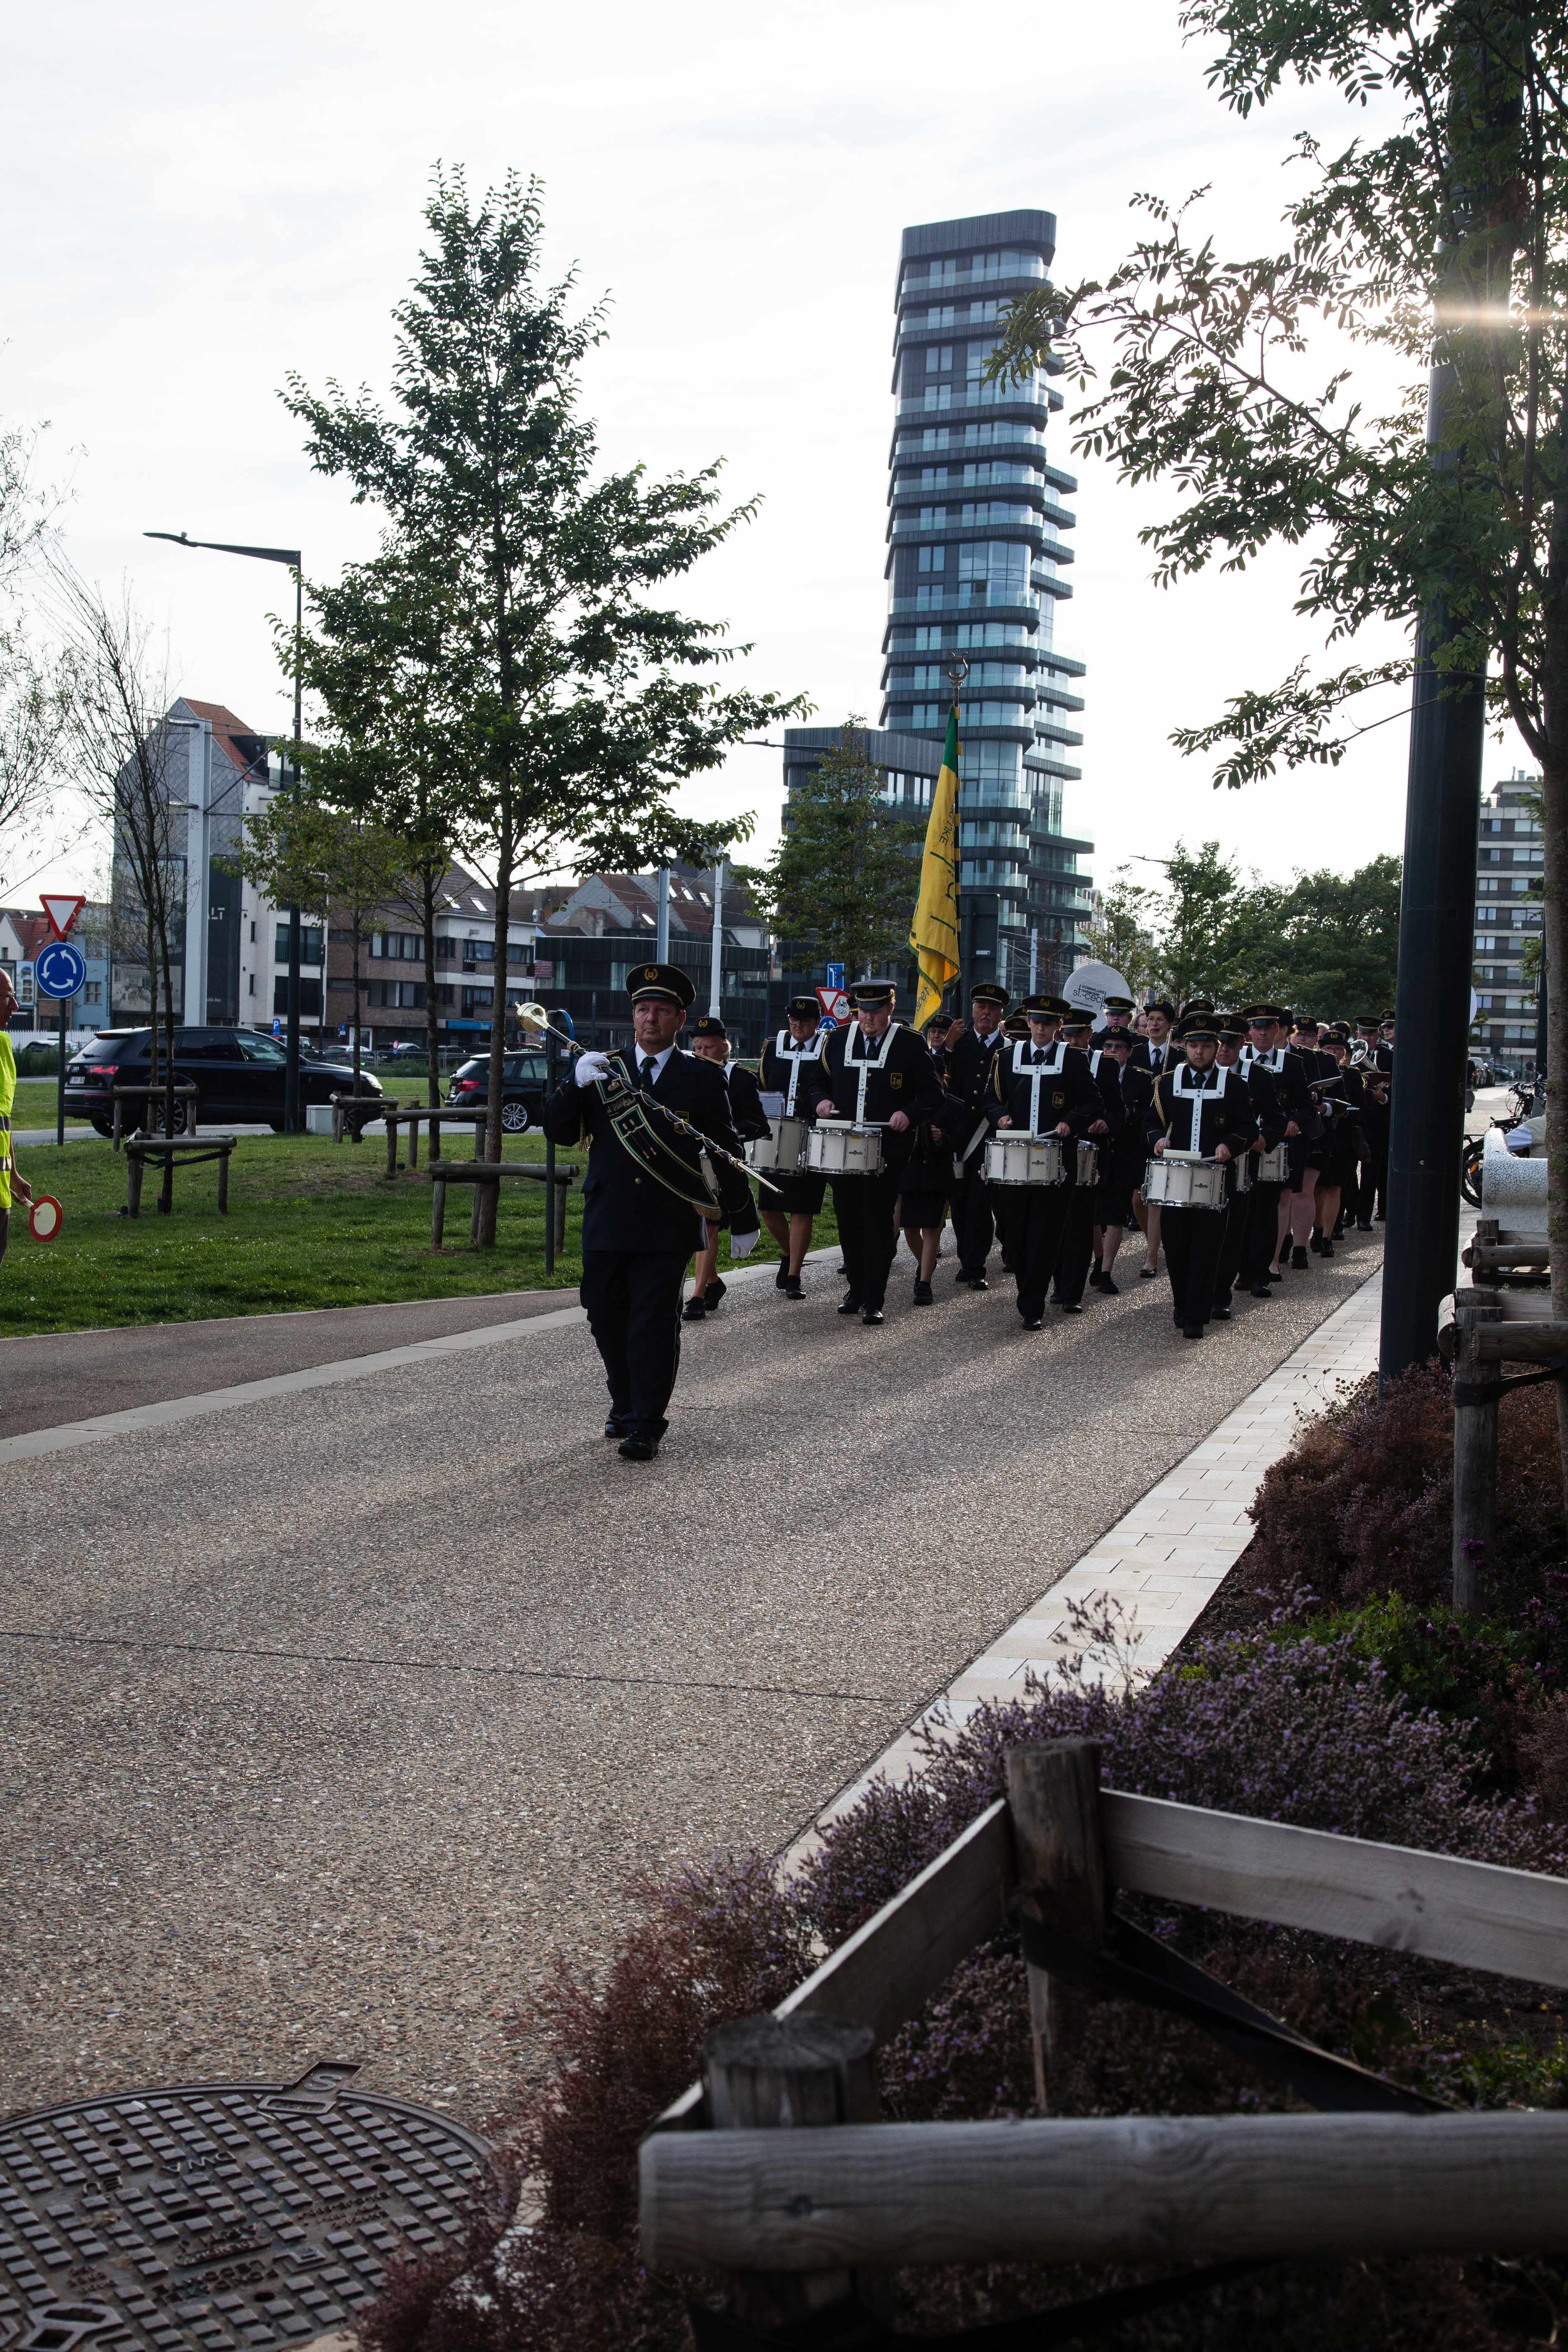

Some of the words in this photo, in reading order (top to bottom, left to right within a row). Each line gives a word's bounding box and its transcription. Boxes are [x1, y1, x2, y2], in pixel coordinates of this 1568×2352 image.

[1082, 985, 1105, 994] KONINKLIJKE
[273, 1021, 279, 1030] P
[304, 2074, 341, 2092] S
